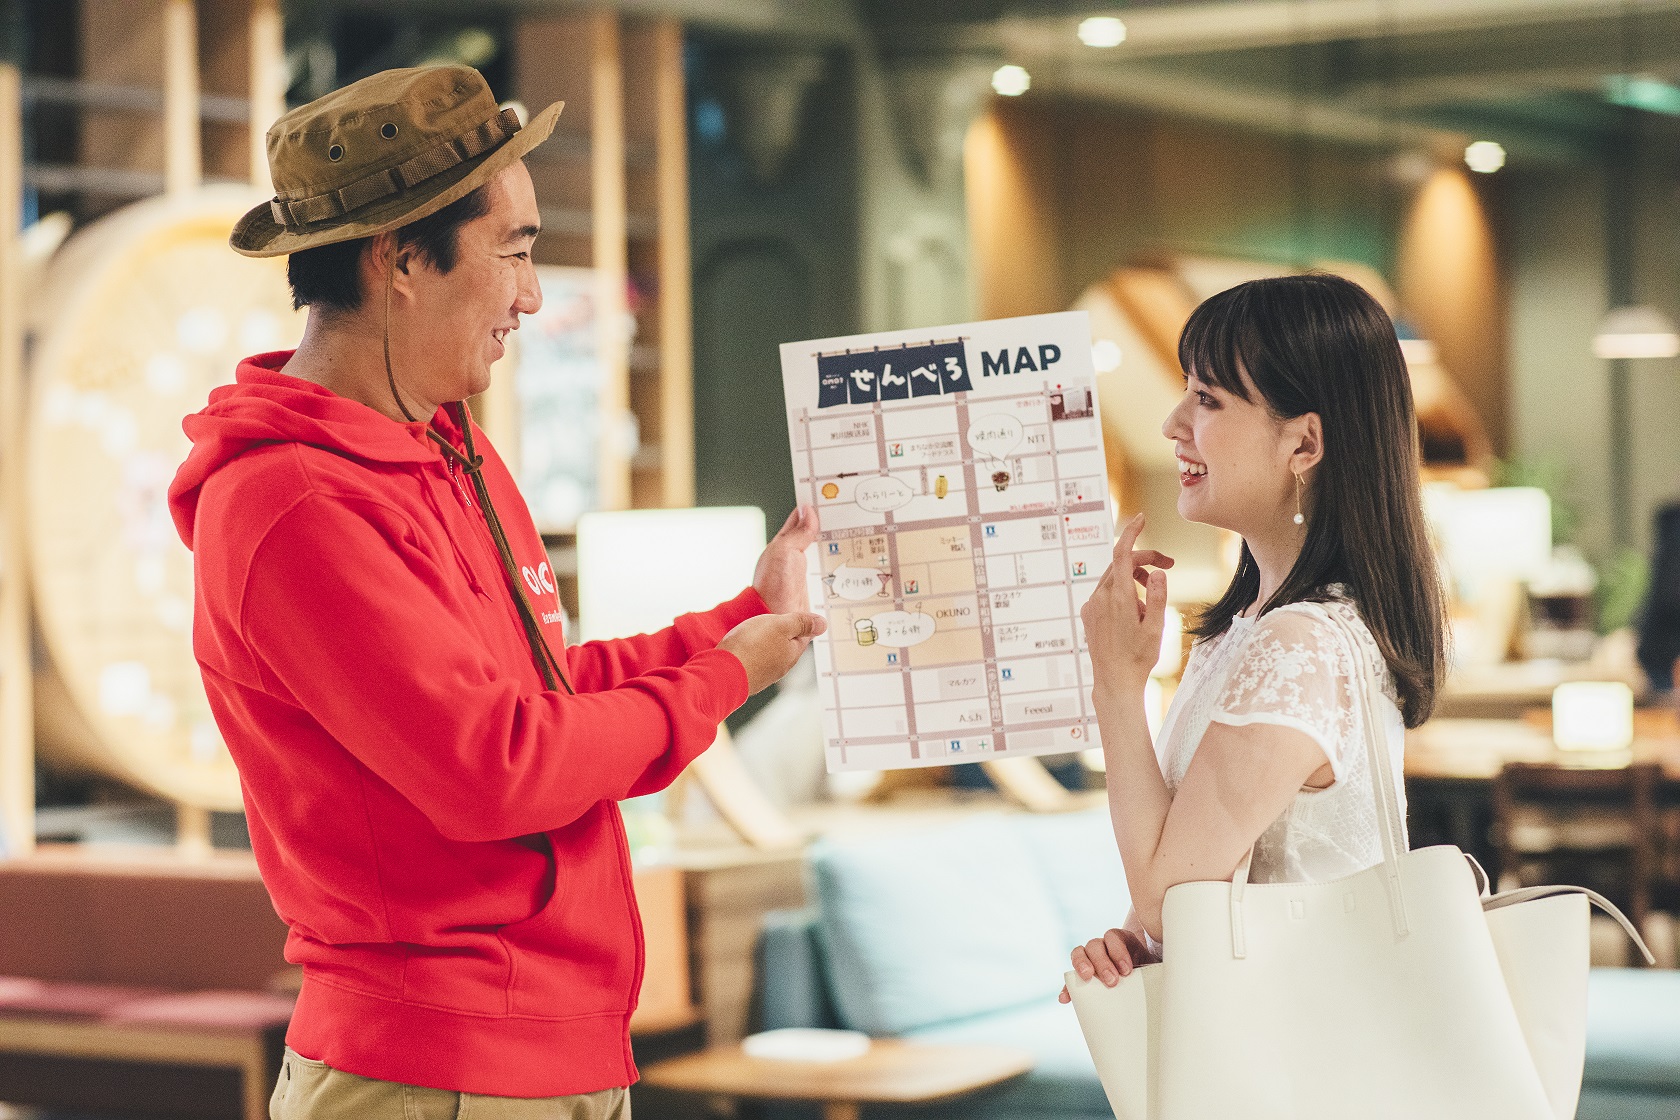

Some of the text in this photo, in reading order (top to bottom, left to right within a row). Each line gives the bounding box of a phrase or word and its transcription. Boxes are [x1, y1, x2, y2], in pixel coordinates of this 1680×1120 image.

[850, 344, 1061, 392] せんべろ MAP
[853, 421, 869, 429] NHK
[974, 428, 1014, 441] 焼肉通り
[1027, 434, 1046, 444] NTT
[935, 607, 971, 618] OKUNO
[999, 626, 1027, 635] ミスター
[949, 678, 976, 687] マルカツ
